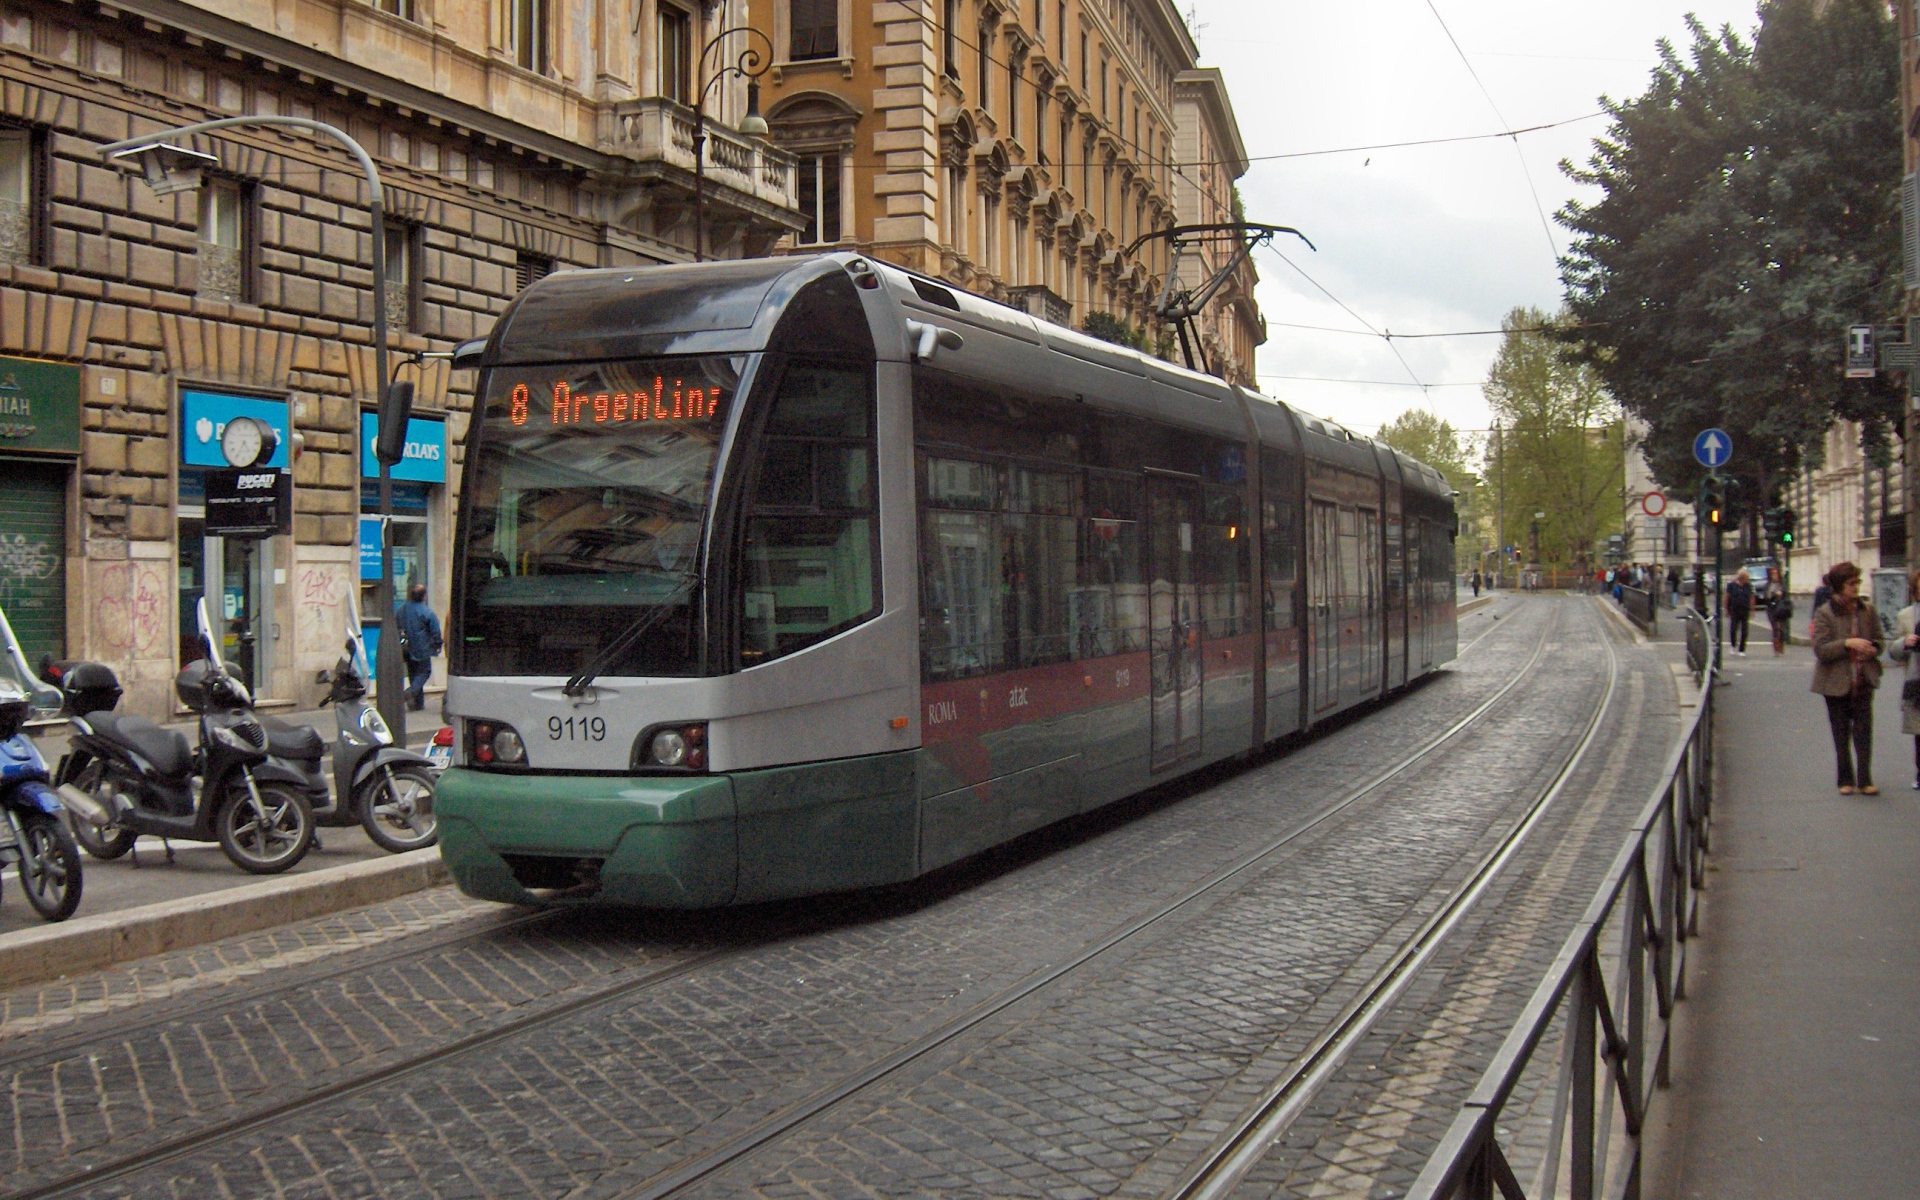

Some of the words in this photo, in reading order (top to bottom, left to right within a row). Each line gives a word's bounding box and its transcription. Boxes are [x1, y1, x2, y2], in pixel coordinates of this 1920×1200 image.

[1851, 328, 1870, 354] T
[0, 396, 30, 416] IAH
[511, 383, 529, 426] 8
[402, 441, 440, 461] RCLAYS
[238, 473, 276, 484] DUCATI
[1009, 686, 1029, 708] atac
[929, 700, 958, 725] ROMA
[548, 716, 606, 742] 9119
